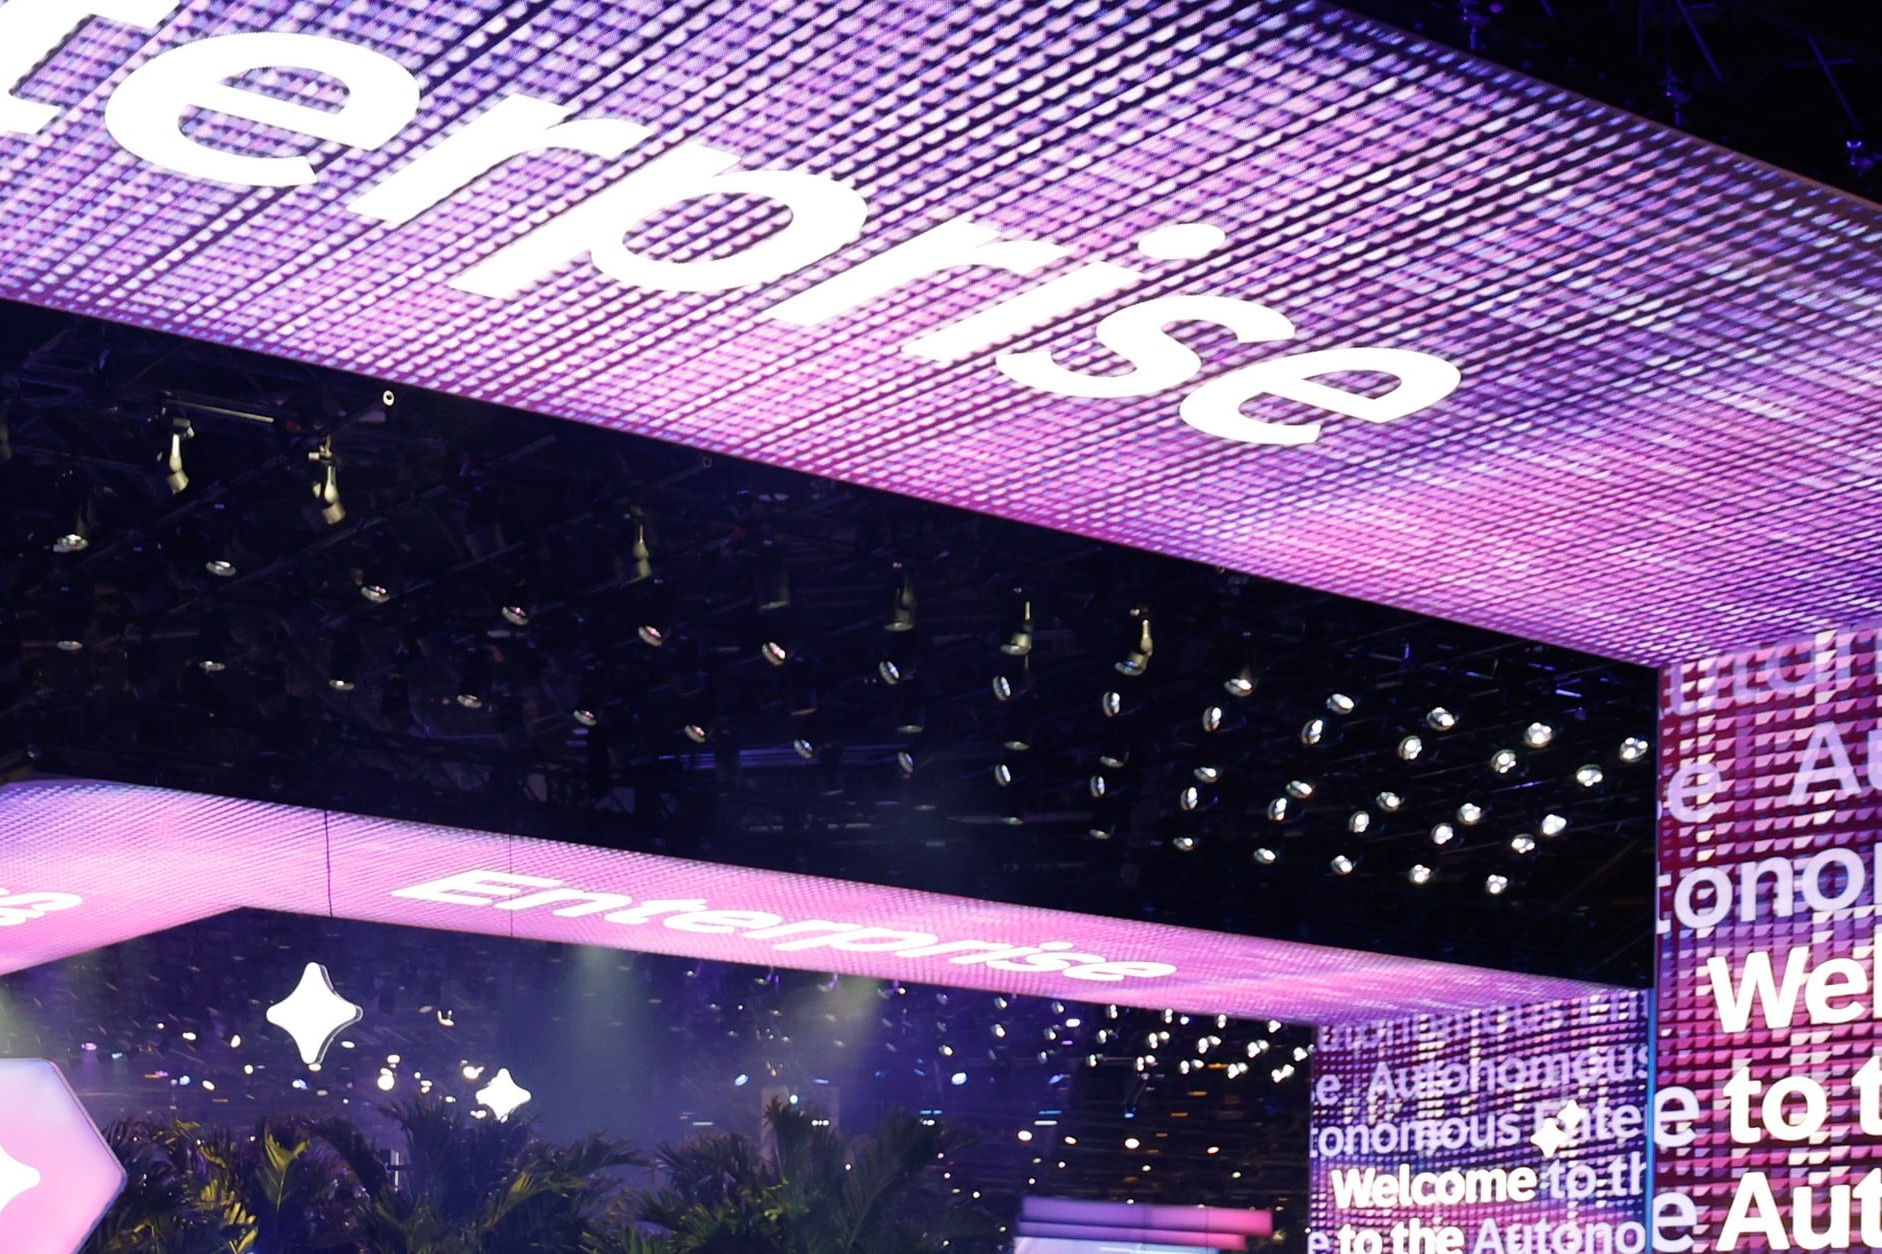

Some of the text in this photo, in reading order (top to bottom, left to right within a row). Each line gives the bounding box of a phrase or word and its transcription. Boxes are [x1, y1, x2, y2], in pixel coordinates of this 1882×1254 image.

[392, 869, 1177, 982] Enterprise
[1723, 1066, 1828, 1143] to
[1331, 1163, 1538, 1209] Welcome
[1550, 1165, 1596, 1200] to
